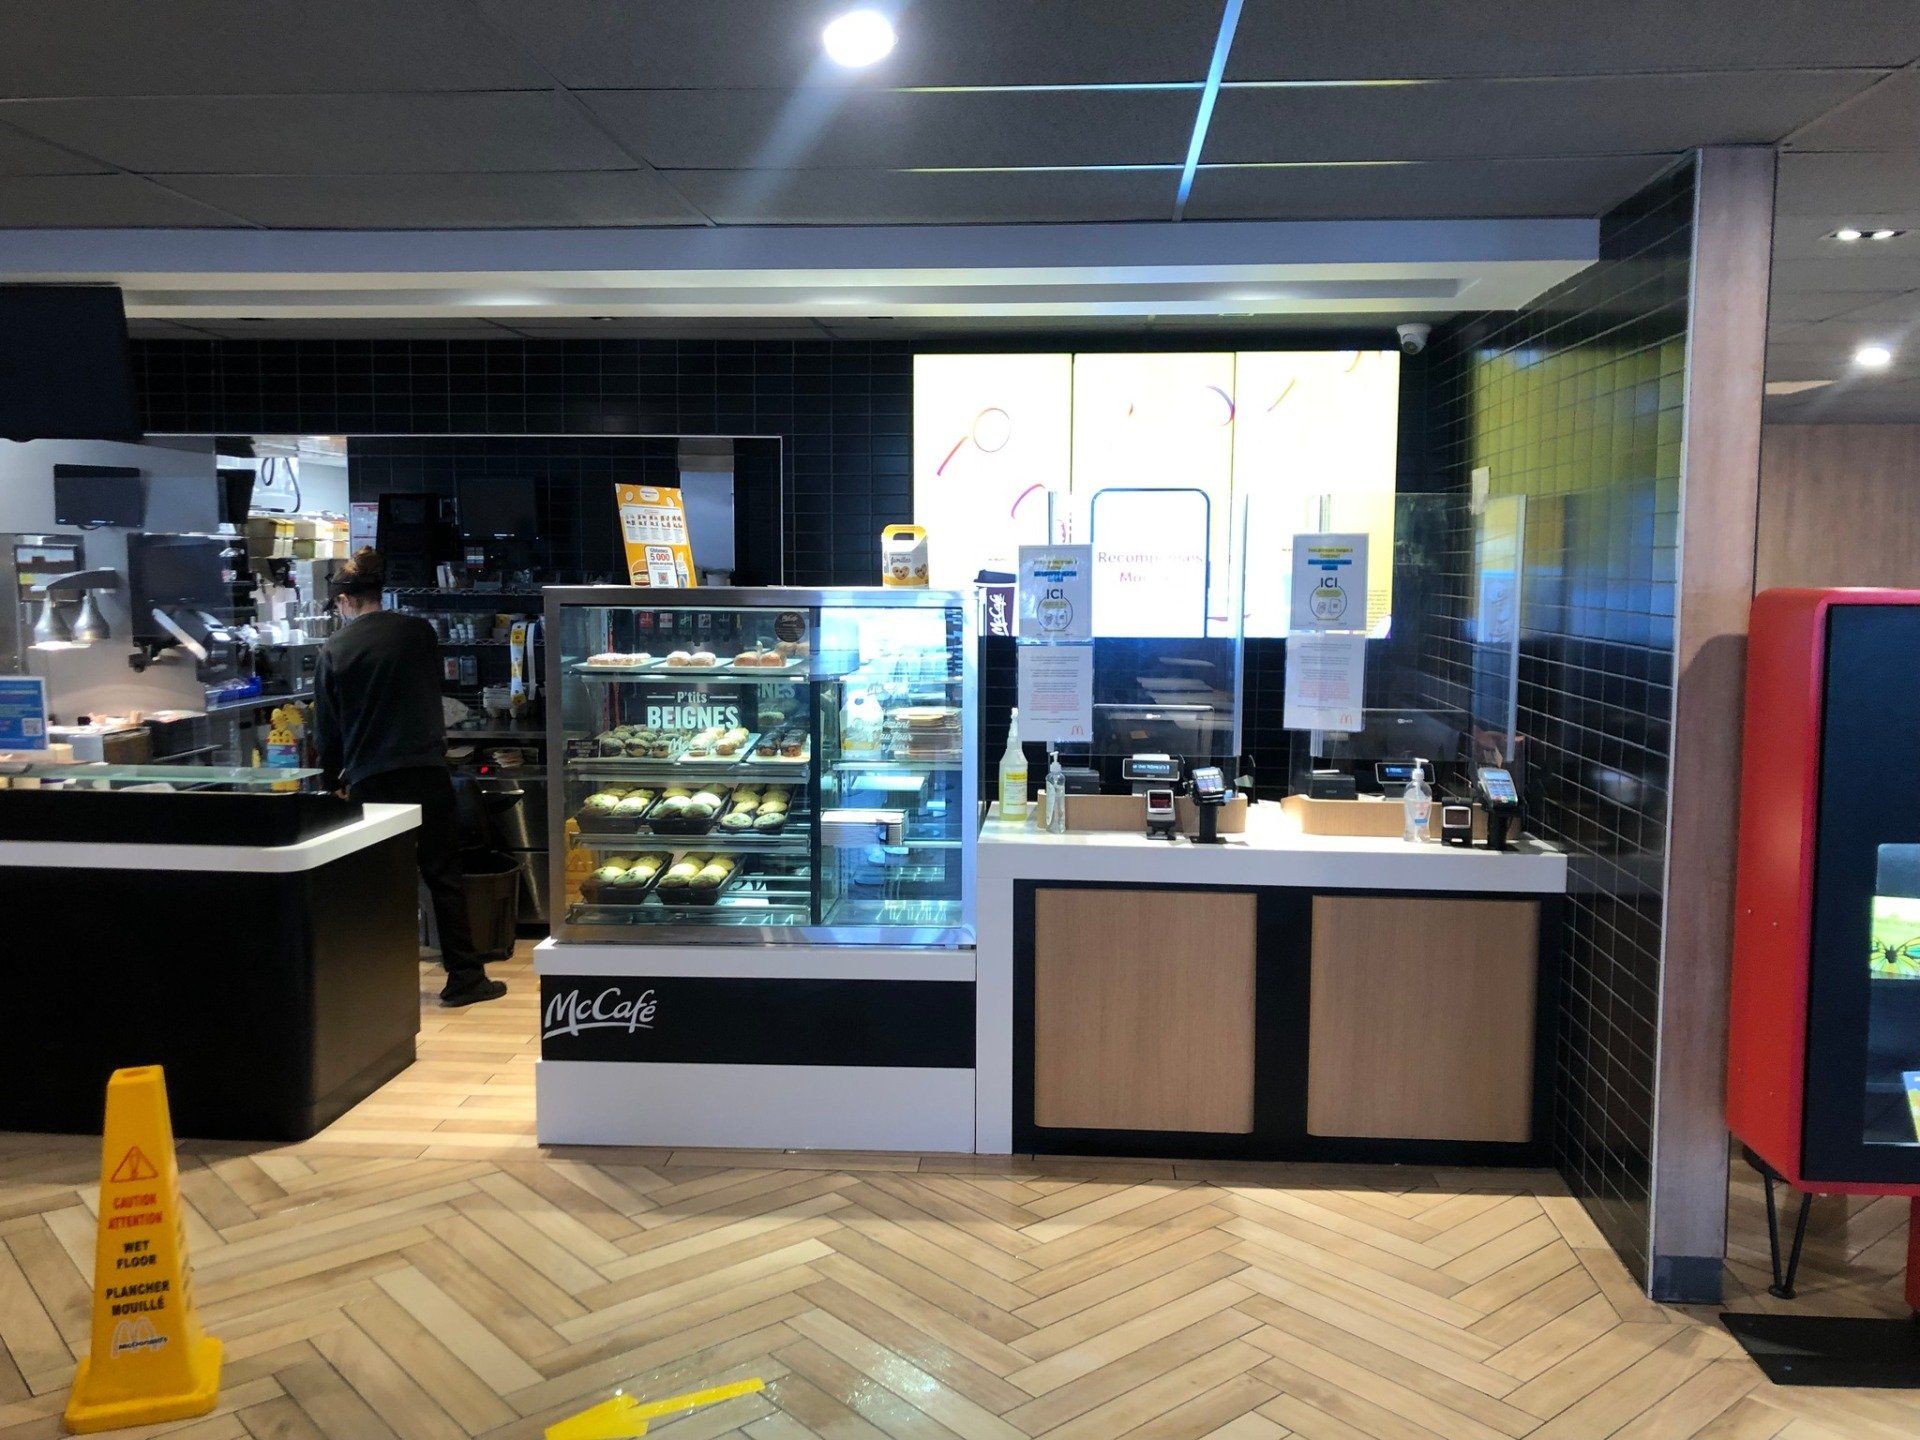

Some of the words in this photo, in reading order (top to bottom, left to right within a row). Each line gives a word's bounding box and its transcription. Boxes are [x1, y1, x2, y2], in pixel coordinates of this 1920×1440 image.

[650, 553, 655, 561] 5
[656, 553, 670, 561] 000
[1320, 577, 1338, 588] ICI
[1046, 588, 1064, 599] ICI
[677, 691, 707, 704] P'tits
[647, 706, 739, 730] BEIGNES
[543, 987, 658, 1038] McCafé
[114, 1194, 156, 1209] CAUTION
[108, 1212, 162, 1229] ATTENTION
[123, 1240, 150, 1253] WET
[116, 1254, 157, 1269] FLOOR
[106, 1281, 169, 1299] PLANCHER
[112, 1295, 165, 1316] MOUILLÉ
